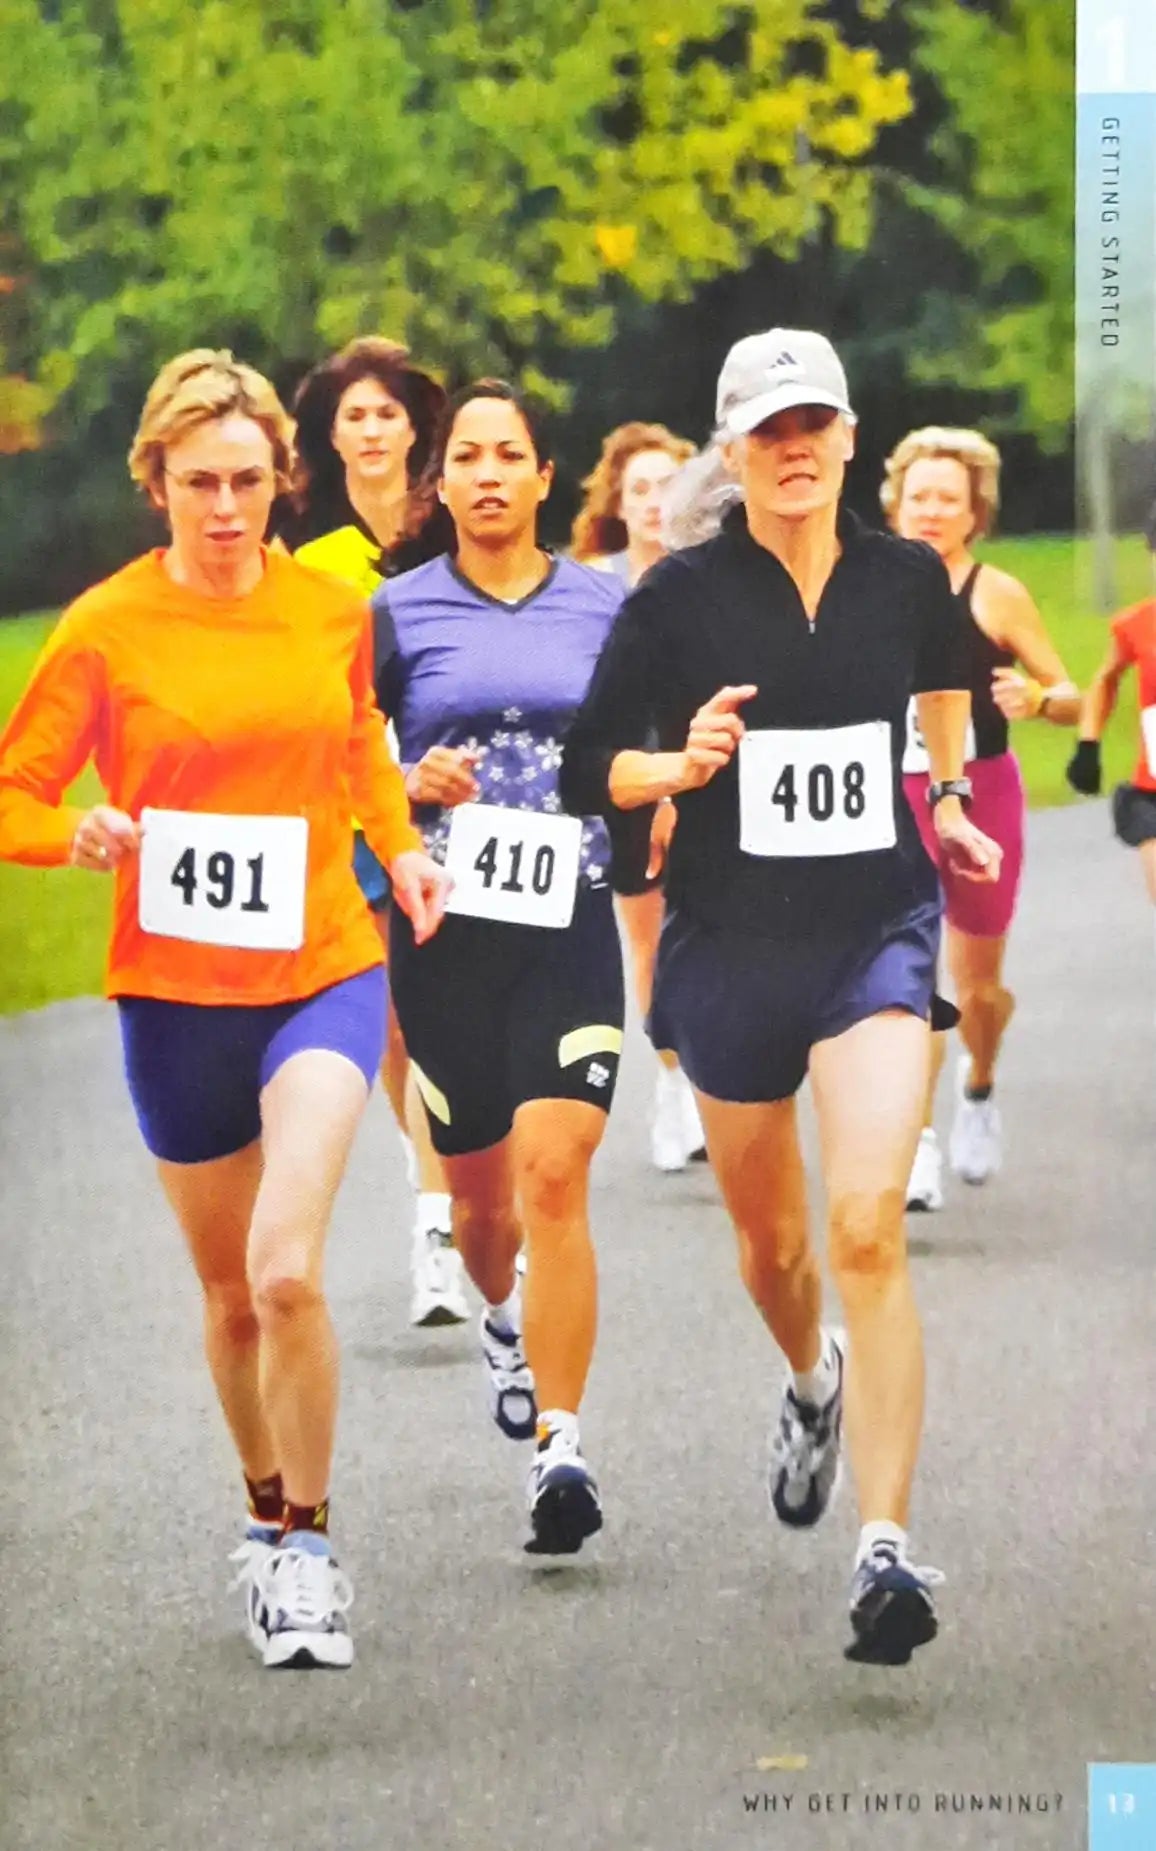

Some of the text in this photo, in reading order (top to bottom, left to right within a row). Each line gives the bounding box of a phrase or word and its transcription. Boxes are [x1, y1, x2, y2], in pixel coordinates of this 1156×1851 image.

[1100, 117, 1120, 347] GETTING STARTED
[771, 761, 866, 823] 408
[170, 846, 269, 912] 491
[474, 836, 555, 895] 410
[743, 1793, 1063, 1814] WHY GET INTO RUNNING?
[1108, 1793, 1135, 1814] 13
